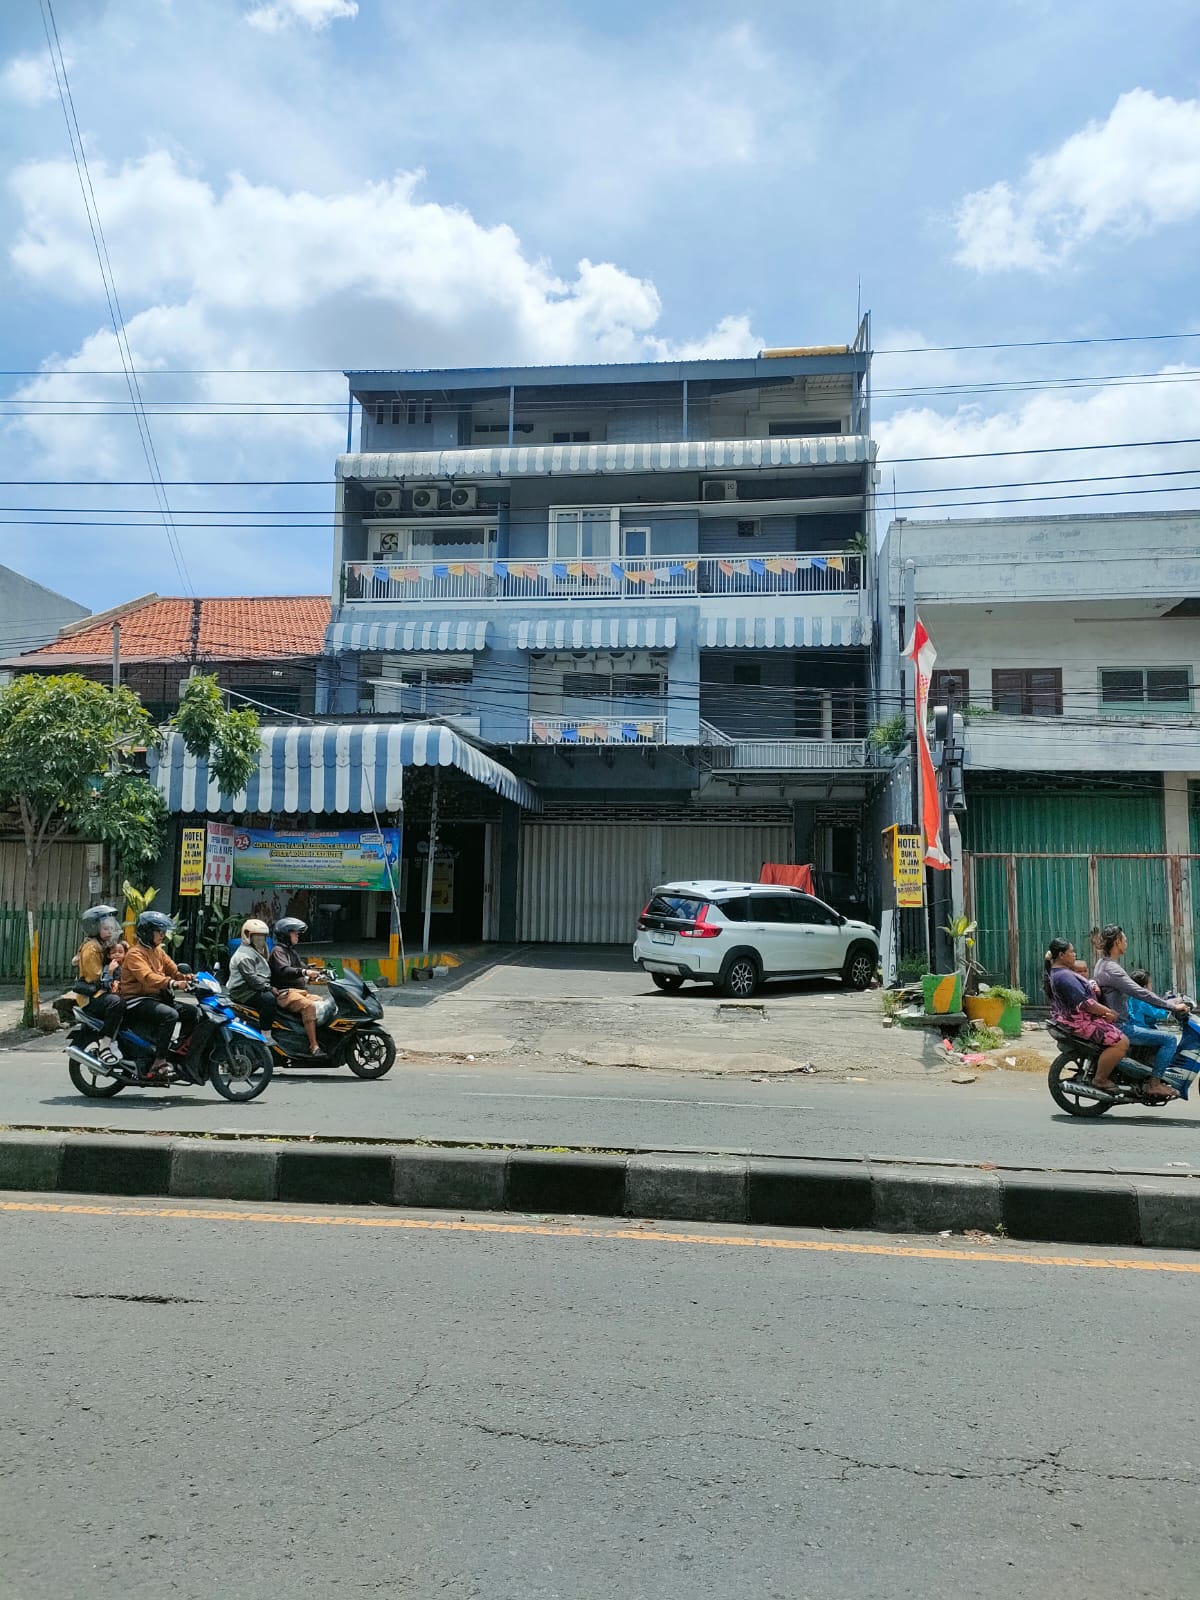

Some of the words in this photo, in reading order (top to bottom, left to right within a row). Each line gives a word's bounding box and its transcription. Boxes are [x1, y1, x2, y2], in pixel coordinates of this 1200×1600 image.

[184, 831, 203, 842] HOTEL
[235, 836, 250, 848] 24
[898, 839, 920, 849] HOTEL
[184, 850, 191, 858] 24
[191, 850, 202, 858] JAM
